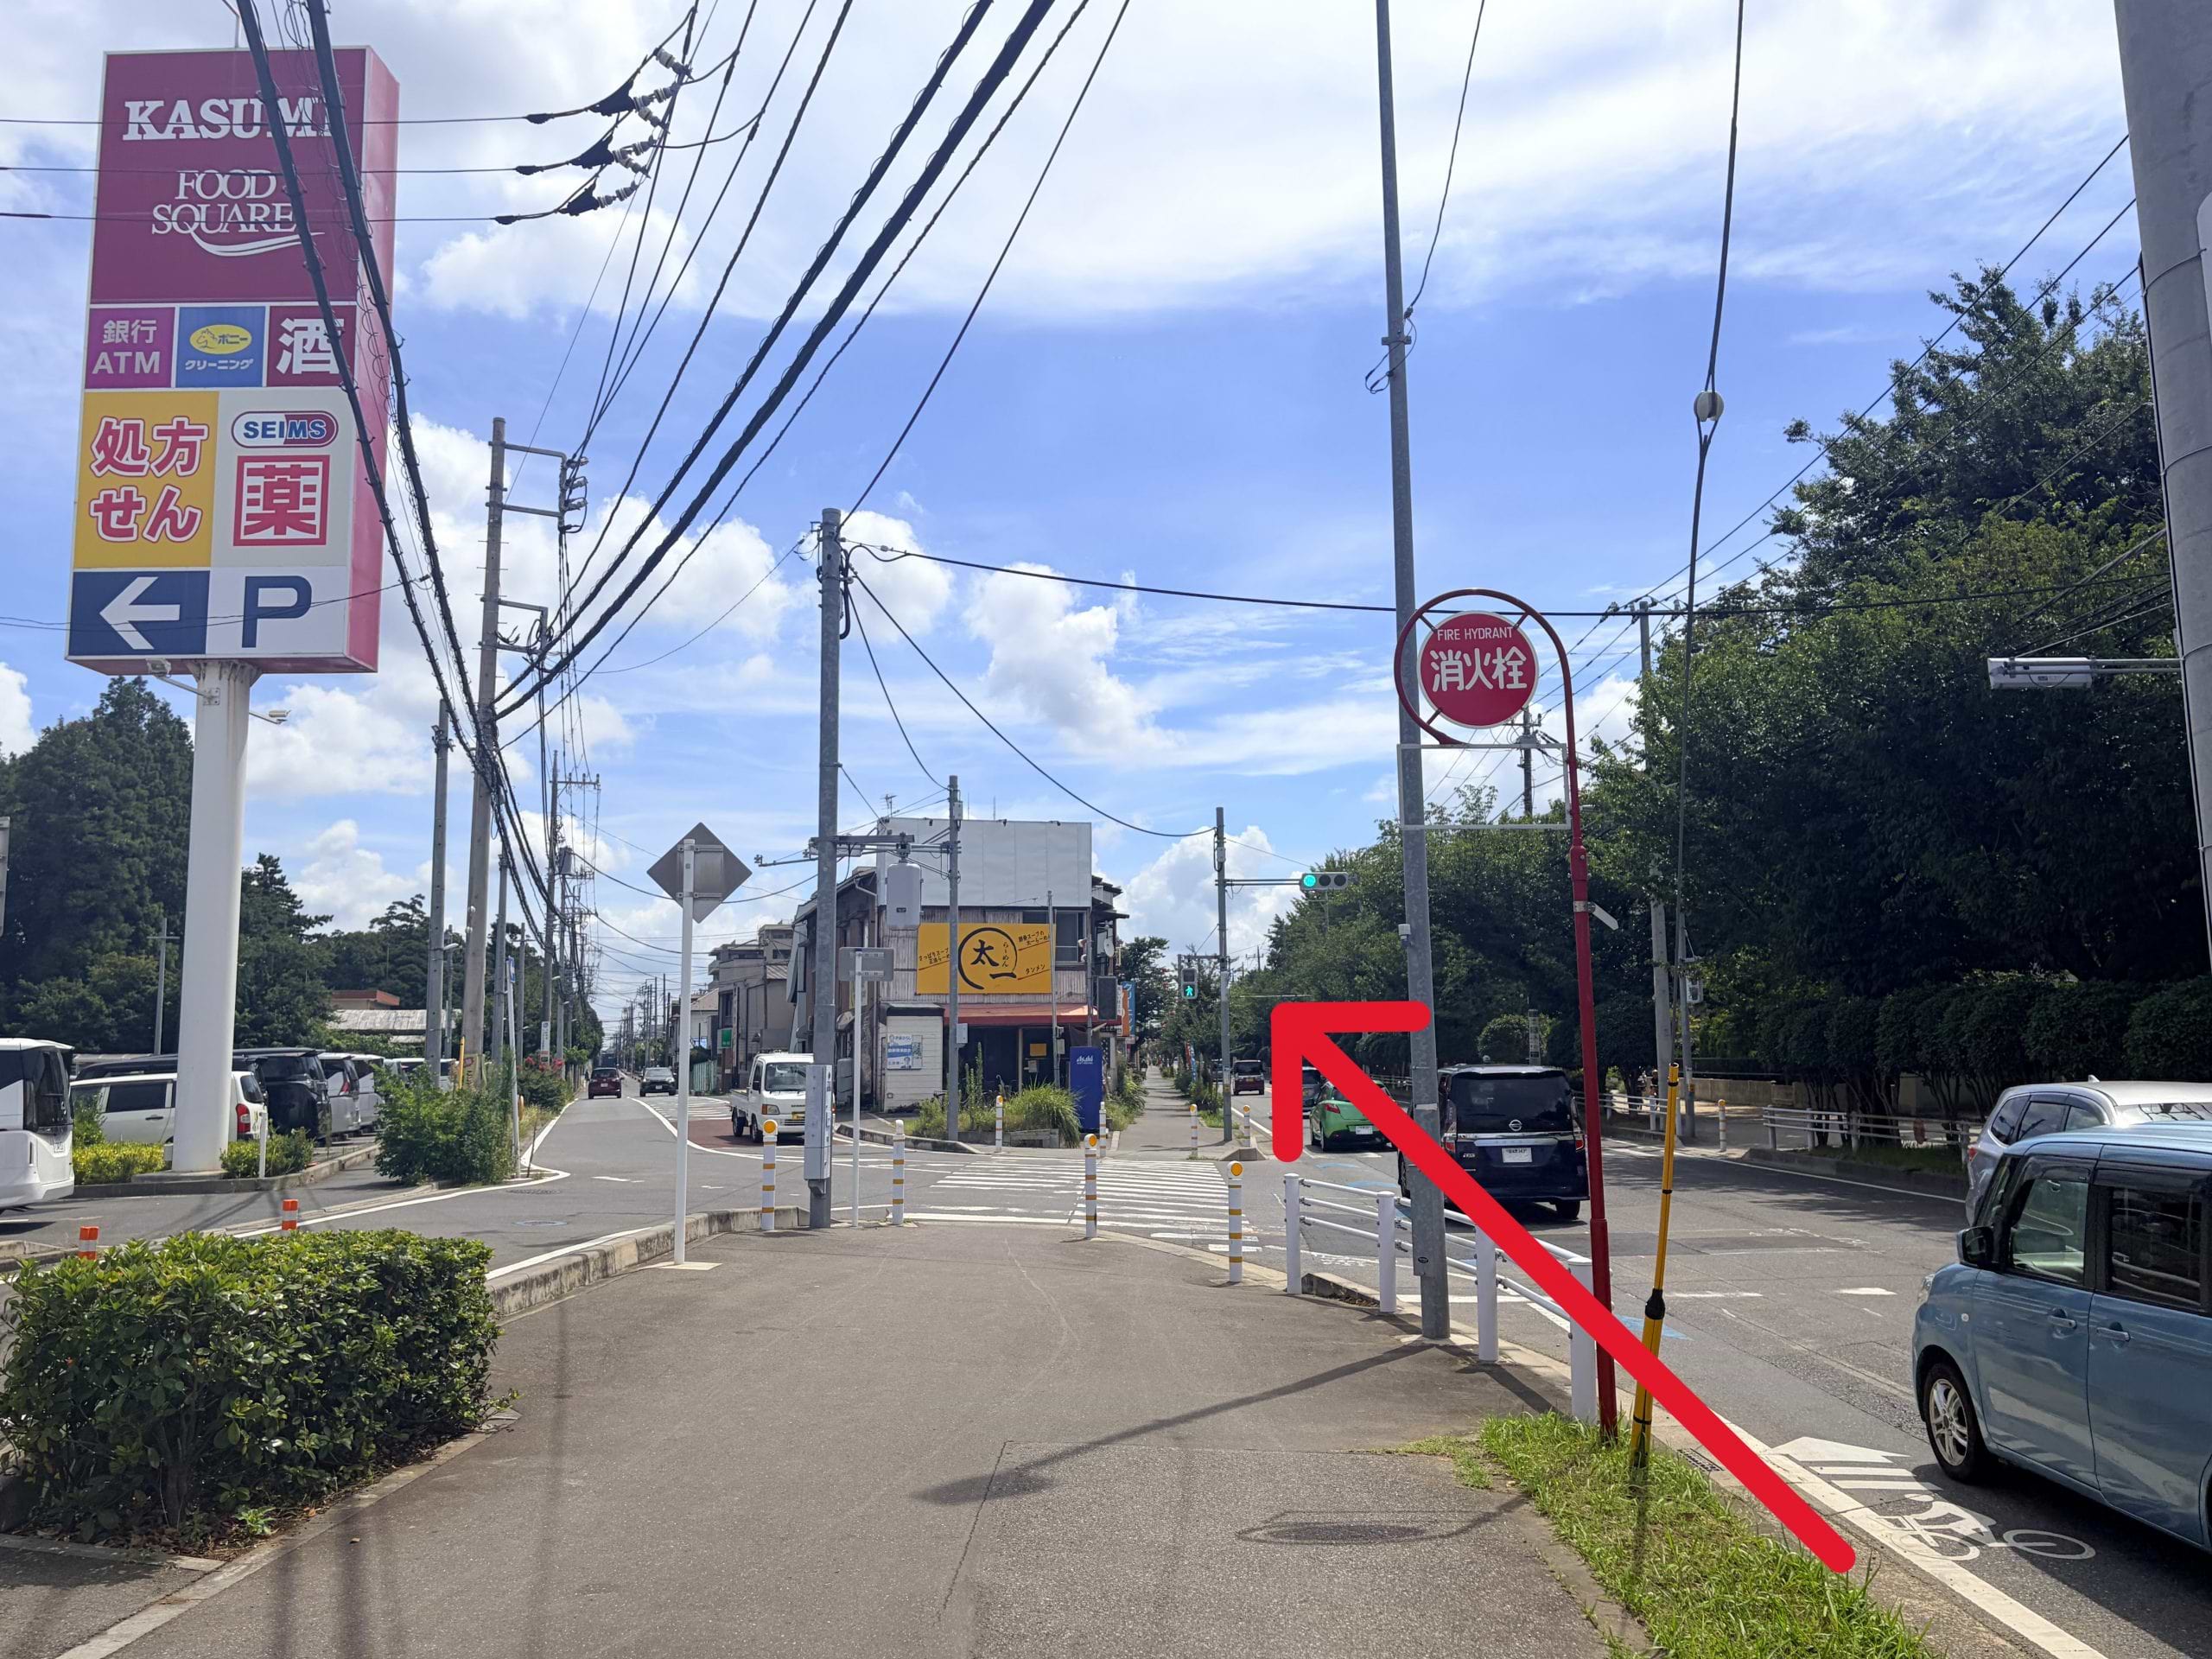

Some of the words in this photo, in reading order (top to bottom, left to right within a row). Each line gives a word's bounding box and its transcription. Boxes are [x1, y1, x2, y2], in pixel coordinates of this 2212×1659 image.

[175, 169, 277, 200] FOOD
[151, 201, 306, 245] SQUARE
[102, 320, 157, 344] 銀行
[276, 317, 345, 375] 酒
[92, 351, 161, 374] ATM
[185, 359, 254, 371] クリーニング
[91, 416, 209, 477] 処方
[243, 420, 327, 440] SEIMS
[89, 484, 203, 543] せん
[244, 464, 320, 536] 薬
[241, 575, 312, 648] P
[1437, 627, 1460, 641] FIRE
[1465, 626, 1513, 639] HYDRANT
[1430, 645, 1528, 692] 消火栓
